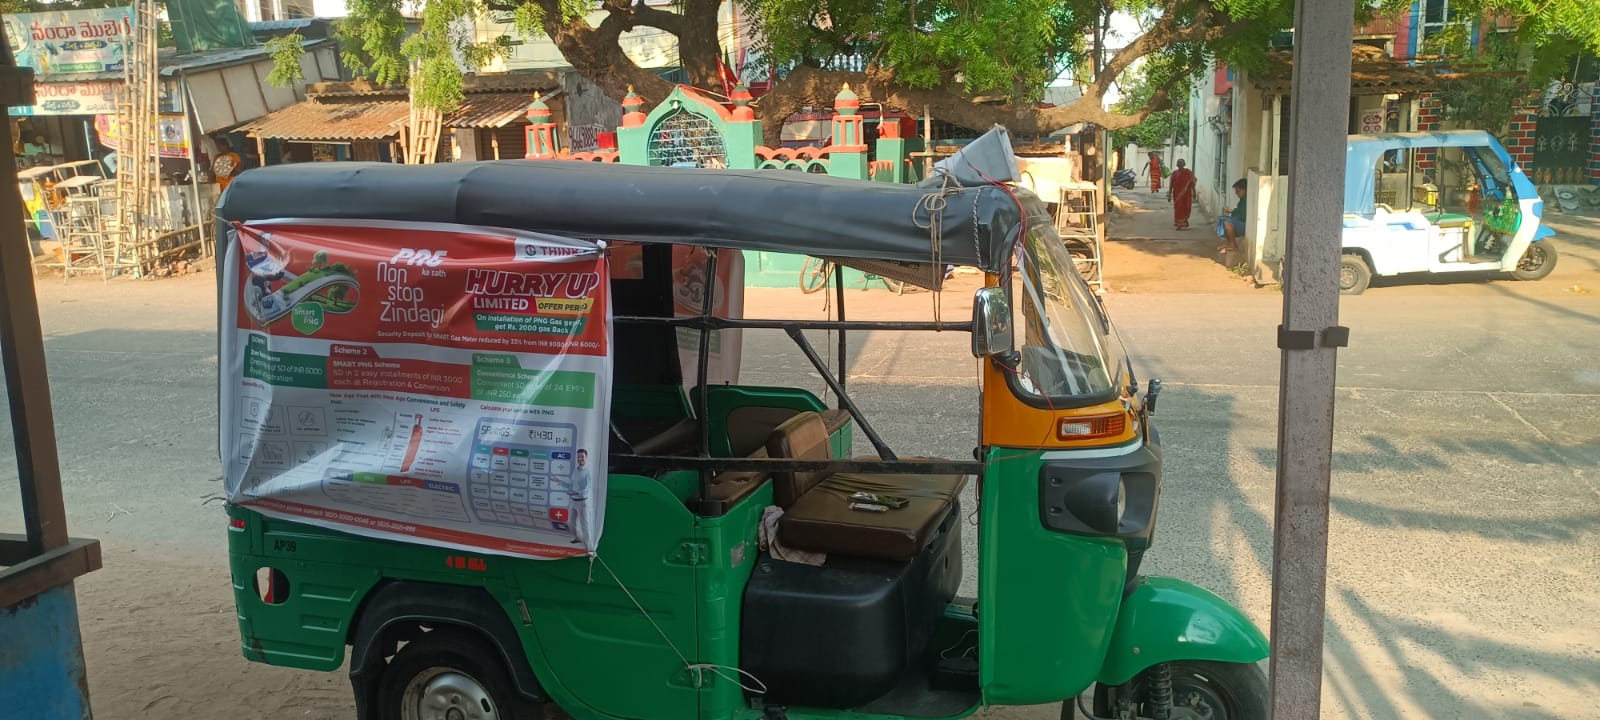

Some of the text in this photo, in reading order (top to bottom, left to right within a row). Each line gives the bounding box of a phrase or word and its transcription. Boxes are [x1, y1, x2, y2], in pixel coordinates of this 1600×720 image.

[30, 21, 76, 40] నందా
[377, 262, 407, 283] Non
[465, 268, 600, 299] HURRY UP
[388, 283, 424, 304] stop
[474, 298, 528, 311] LIMITED
[538, 302, 565, 311] OFFER
[294, 307, 319, 326] Smart PNG
[380, 301, 445, 328] Zindagi
[488, 315, 523, 323] installation
[533, 317, 548, 325] PNG
[378, 330, 401, 339] Security
[403, 331, 425, 339] Deposit
[495, 323, 506, 332] get
[552, 326, 569, 334] Back
[334, 346, 361, 354] Scheme
[362, 378, 407, 387] Registration
[443, 376, 463, 384] 3000
[499, 390, 511, 398] 250
[450, 400, 466, 409] Safety
[274, 539, 296, 552] AP39
